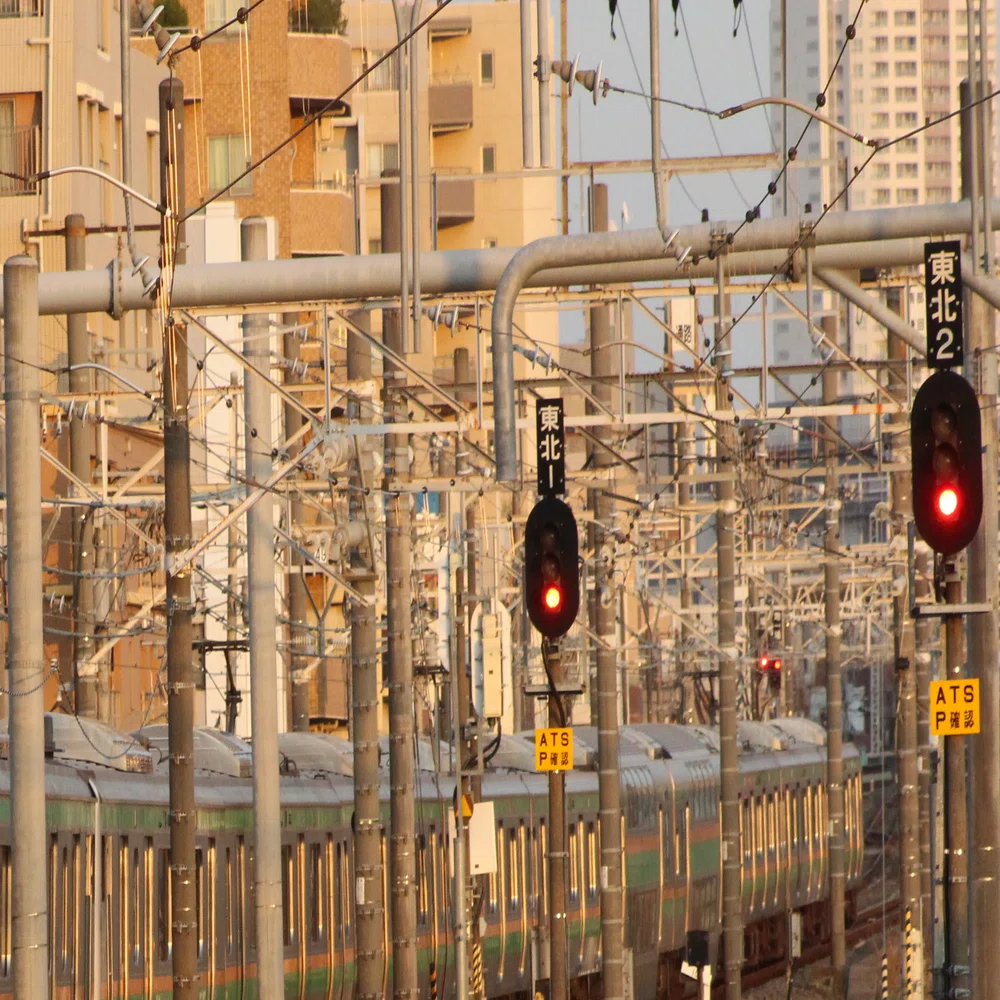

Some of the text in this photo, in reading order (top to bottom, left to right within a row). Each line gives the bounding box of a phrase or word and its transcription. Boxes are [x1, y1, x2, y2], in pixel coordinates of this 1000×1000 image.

[930, 249, 957, 359] 東北2
[936, 684, 974, 705] ATS
[540, 732, 569, 747] ATS
